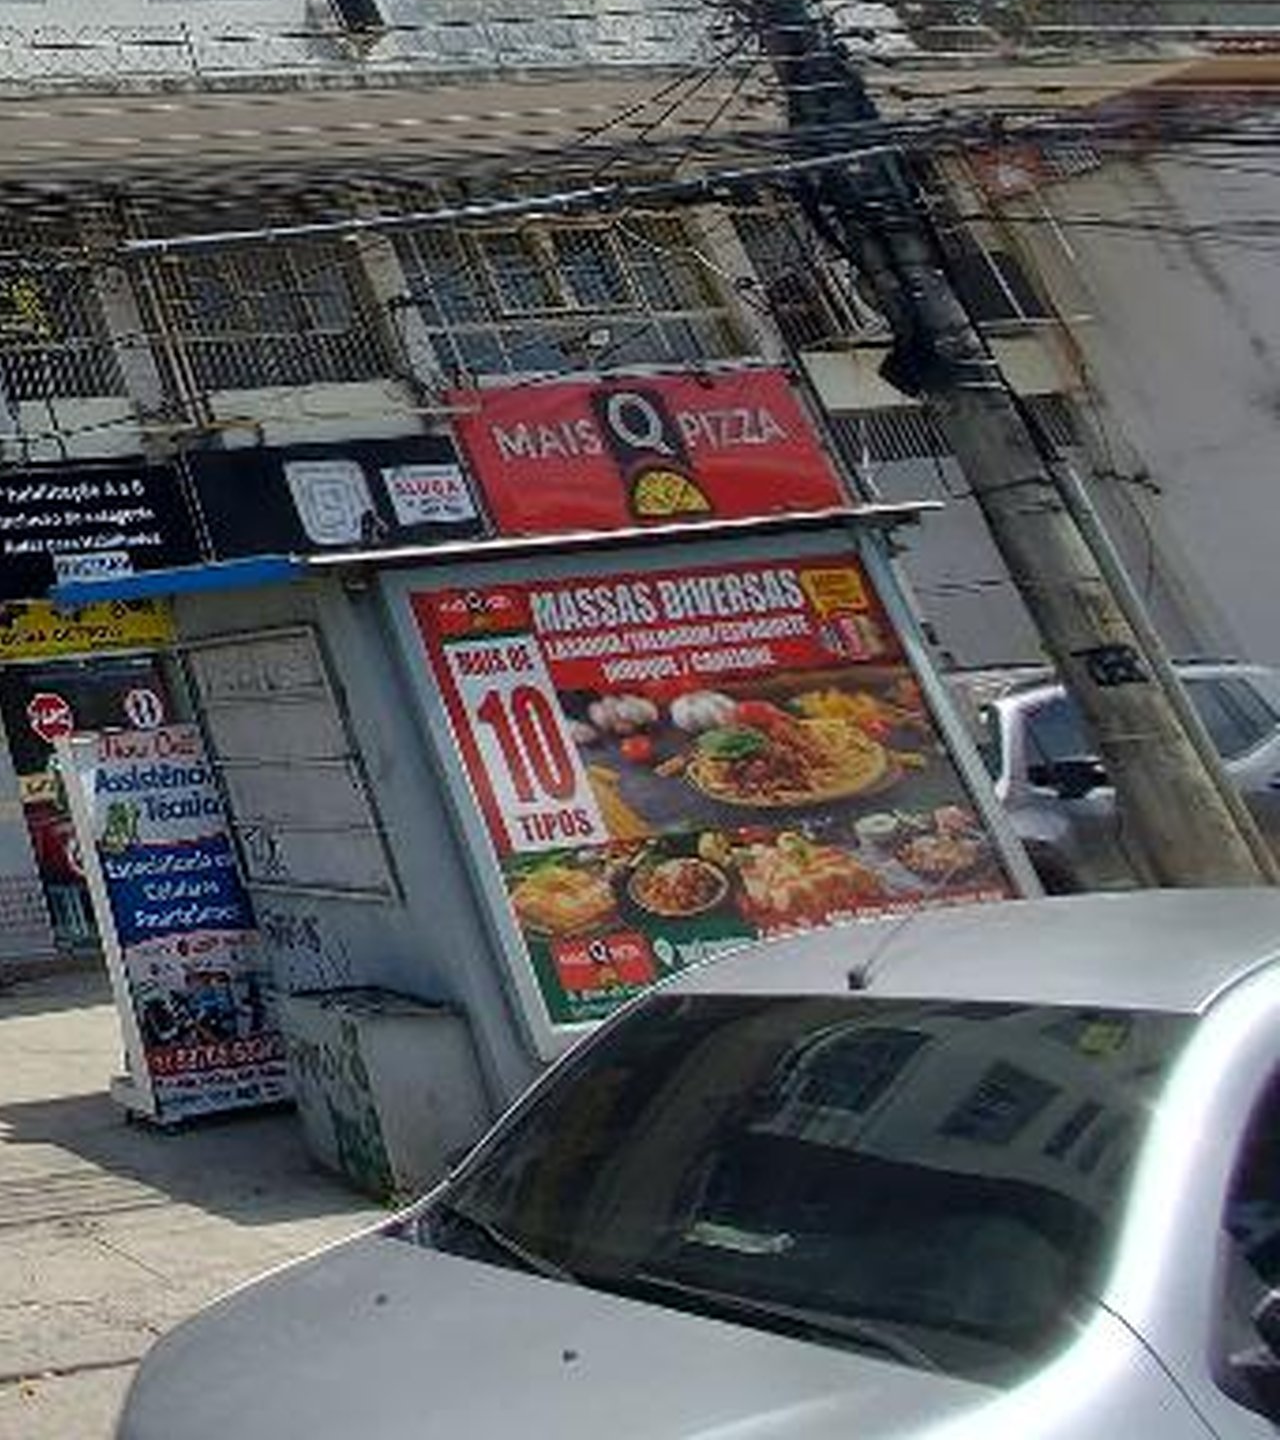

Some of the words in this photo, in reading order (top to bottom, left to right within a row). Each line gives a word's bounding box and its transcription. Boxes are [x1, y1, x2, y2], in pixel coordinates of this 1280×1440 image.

[492, 420, 604, 460] MAIS
[606, 391, 673, 455] Q
[676, 407, 787, 448] PIZZA
[531, 580, 657, 633] MASSAS
[659, 569, 805, 620] DIVERSAS
[475, 686, 577, 804] 10
[516, 809, 595, 843] TIPOS
